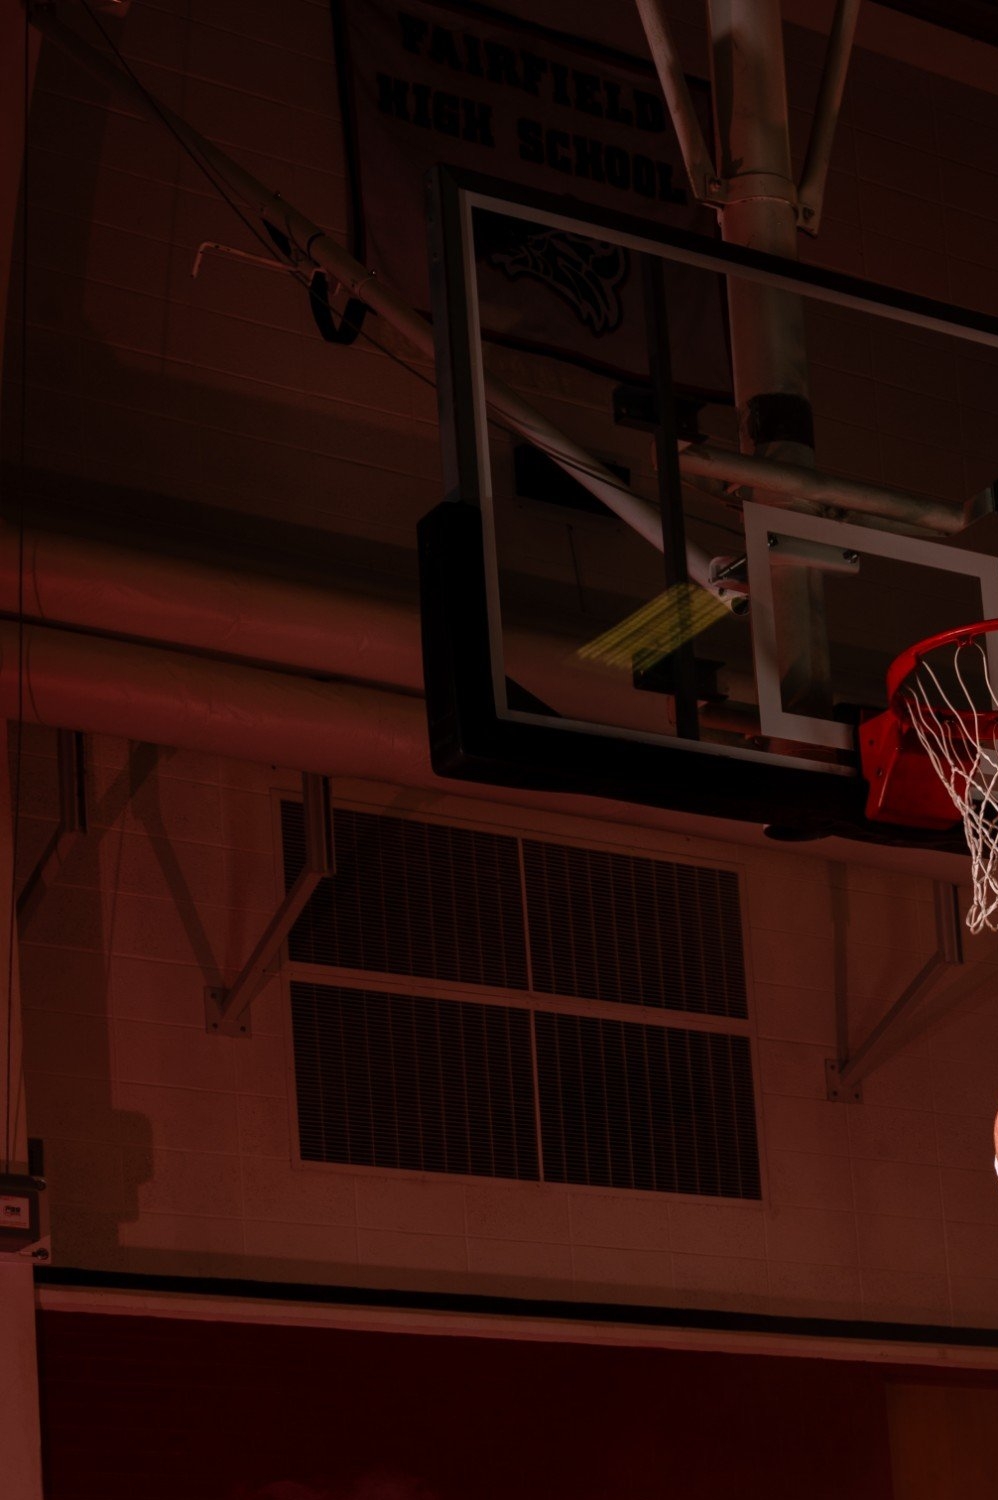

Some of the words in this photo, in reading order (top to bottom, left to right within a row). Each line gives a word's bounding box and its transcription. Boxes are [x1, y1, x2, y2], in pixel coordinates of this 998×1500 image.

[398, 12, 667, 134] FAIRFIELD
[376, 72, 494, 148] HIGH
[517, 118, 688, 206] SCHOOL
